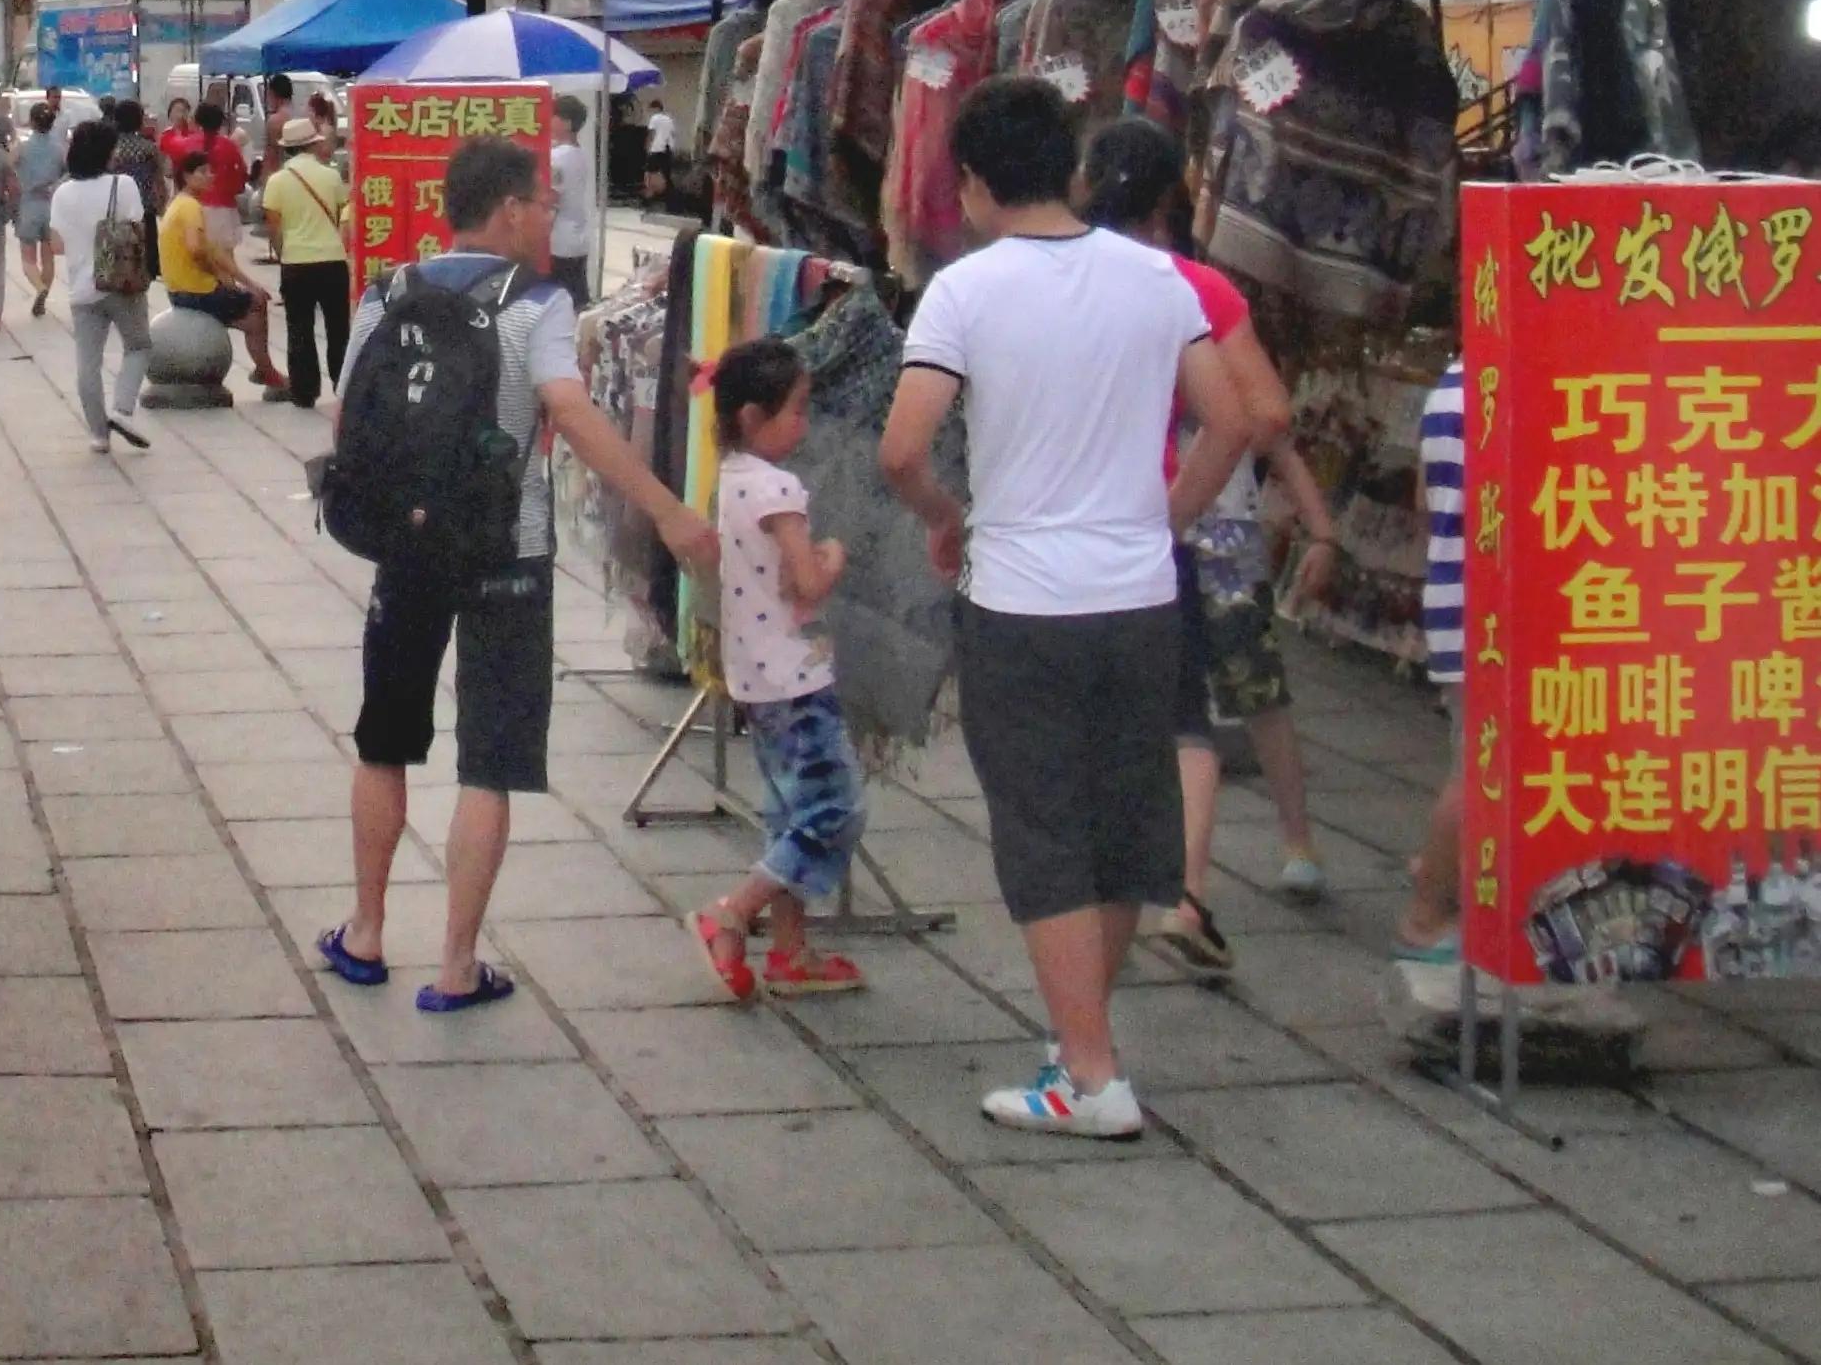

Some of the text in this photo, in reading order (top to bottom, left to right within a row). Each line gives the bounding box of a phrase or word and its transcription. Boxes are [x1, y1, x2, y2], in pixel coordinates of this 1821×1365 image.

[364, 94, 542, 138] 本店保真
[1523, 200, 1821, 309] 批发俄罗
[1531, 462, 1821, 551] 伏特加
[1530, 649, 1821, 740] 咖啡 啤
